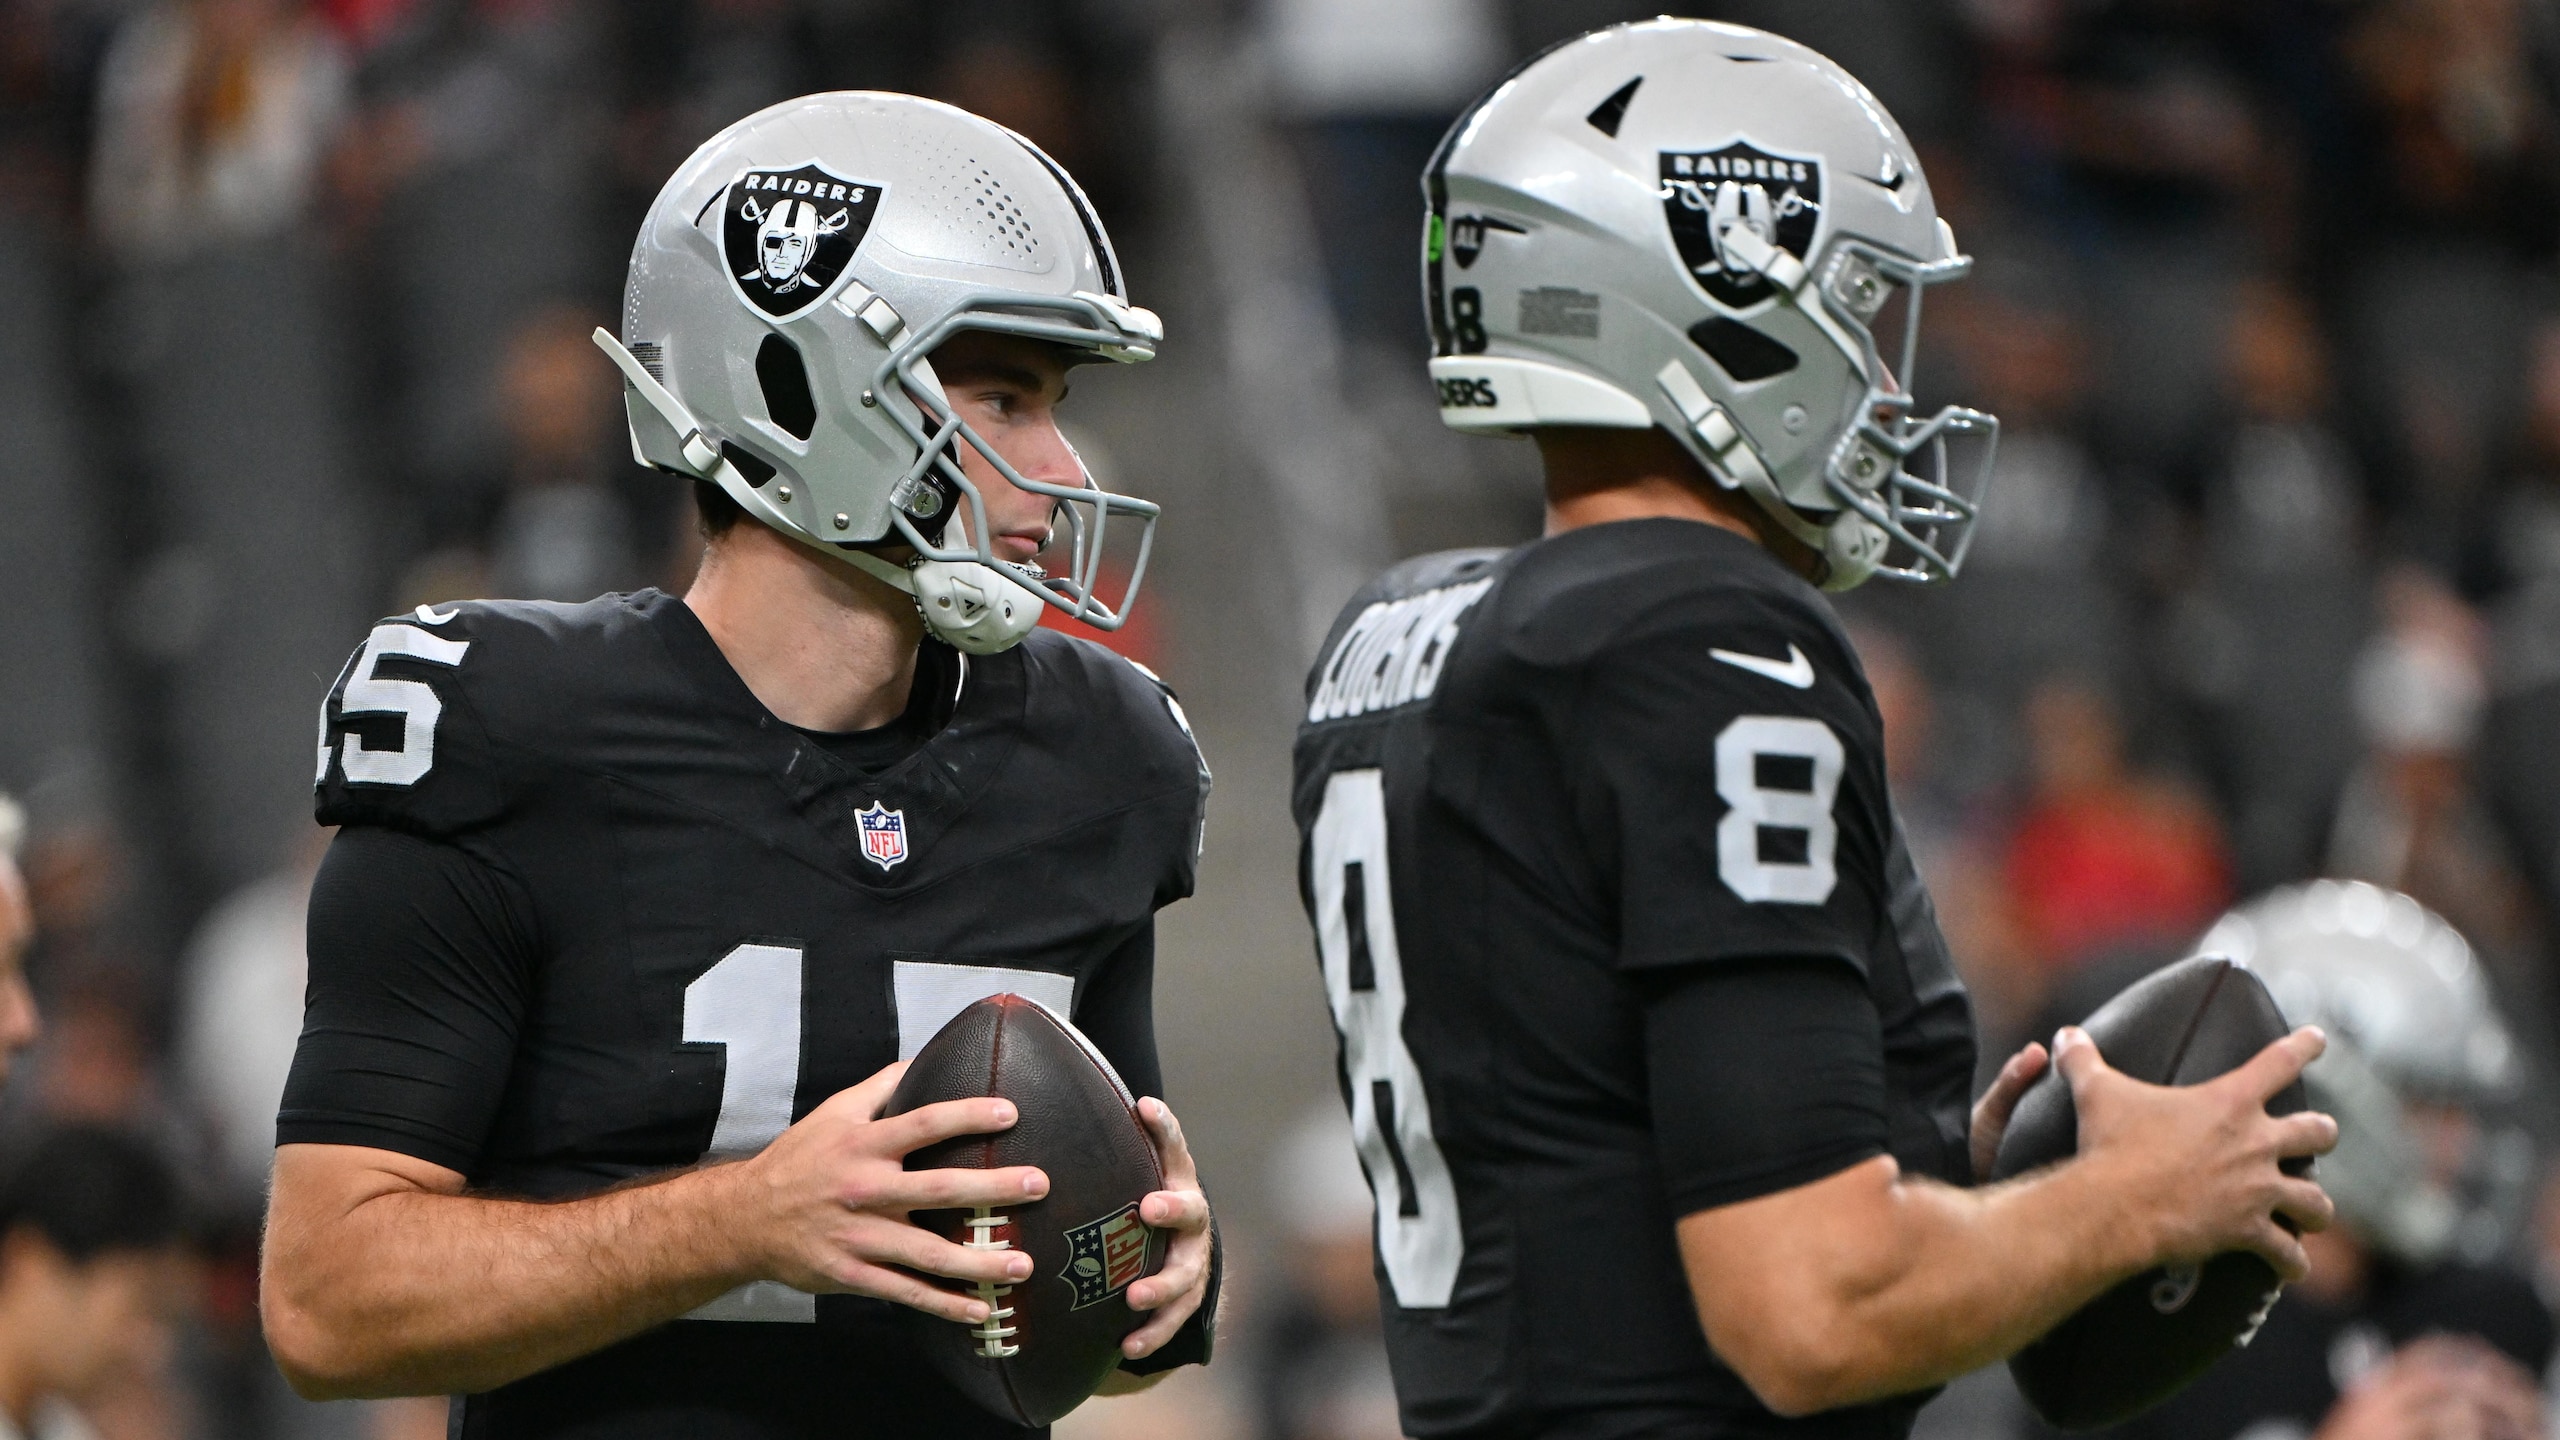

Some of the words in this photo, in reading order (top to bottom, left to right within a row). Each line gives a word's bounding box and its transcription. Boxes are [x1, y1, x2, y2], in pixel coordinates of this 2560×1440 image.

[744, 174, 866, 204] RAIDERS
[1673, 155, 1808, 182] RAIDERS
[1453, 287, 1487, 353] 8
[1715, 715, 1845, 906] 8
[868, 832, 901, 858] NFL
[1313, 768, 1465, 1309] 8
[1105, 1211, 1148, 1292] NFL
